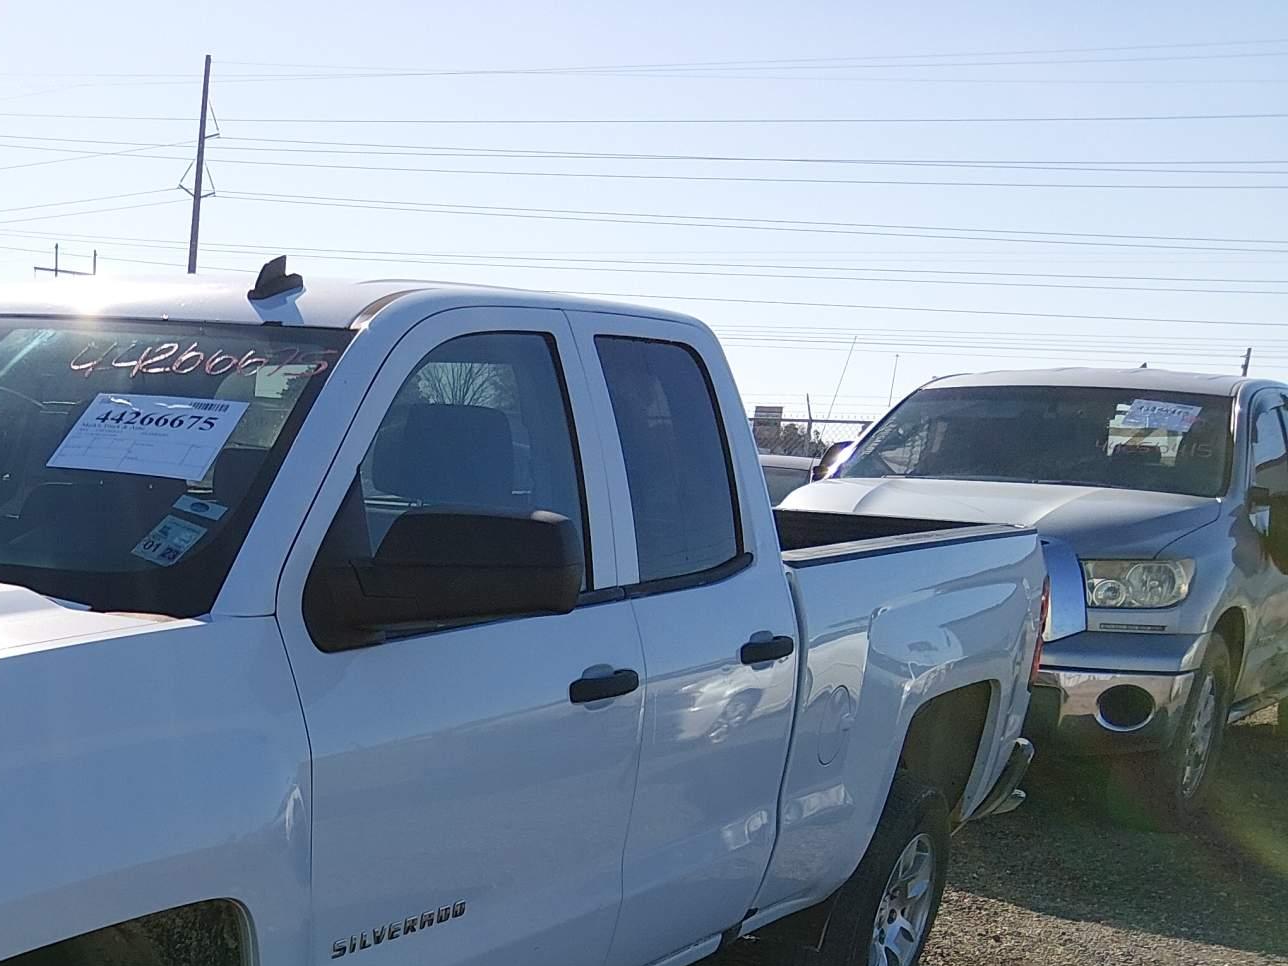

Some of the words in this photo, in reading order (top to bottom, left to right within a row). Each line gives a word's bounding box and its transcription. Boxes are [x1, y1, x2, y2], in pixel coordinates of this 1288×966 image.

[70, 342, 338, 378] 44266675
[95, 409, 219, 431] 44266675
[143, 540, 162, 553] 01
[331, 898, 468, 960] SILVERADO
